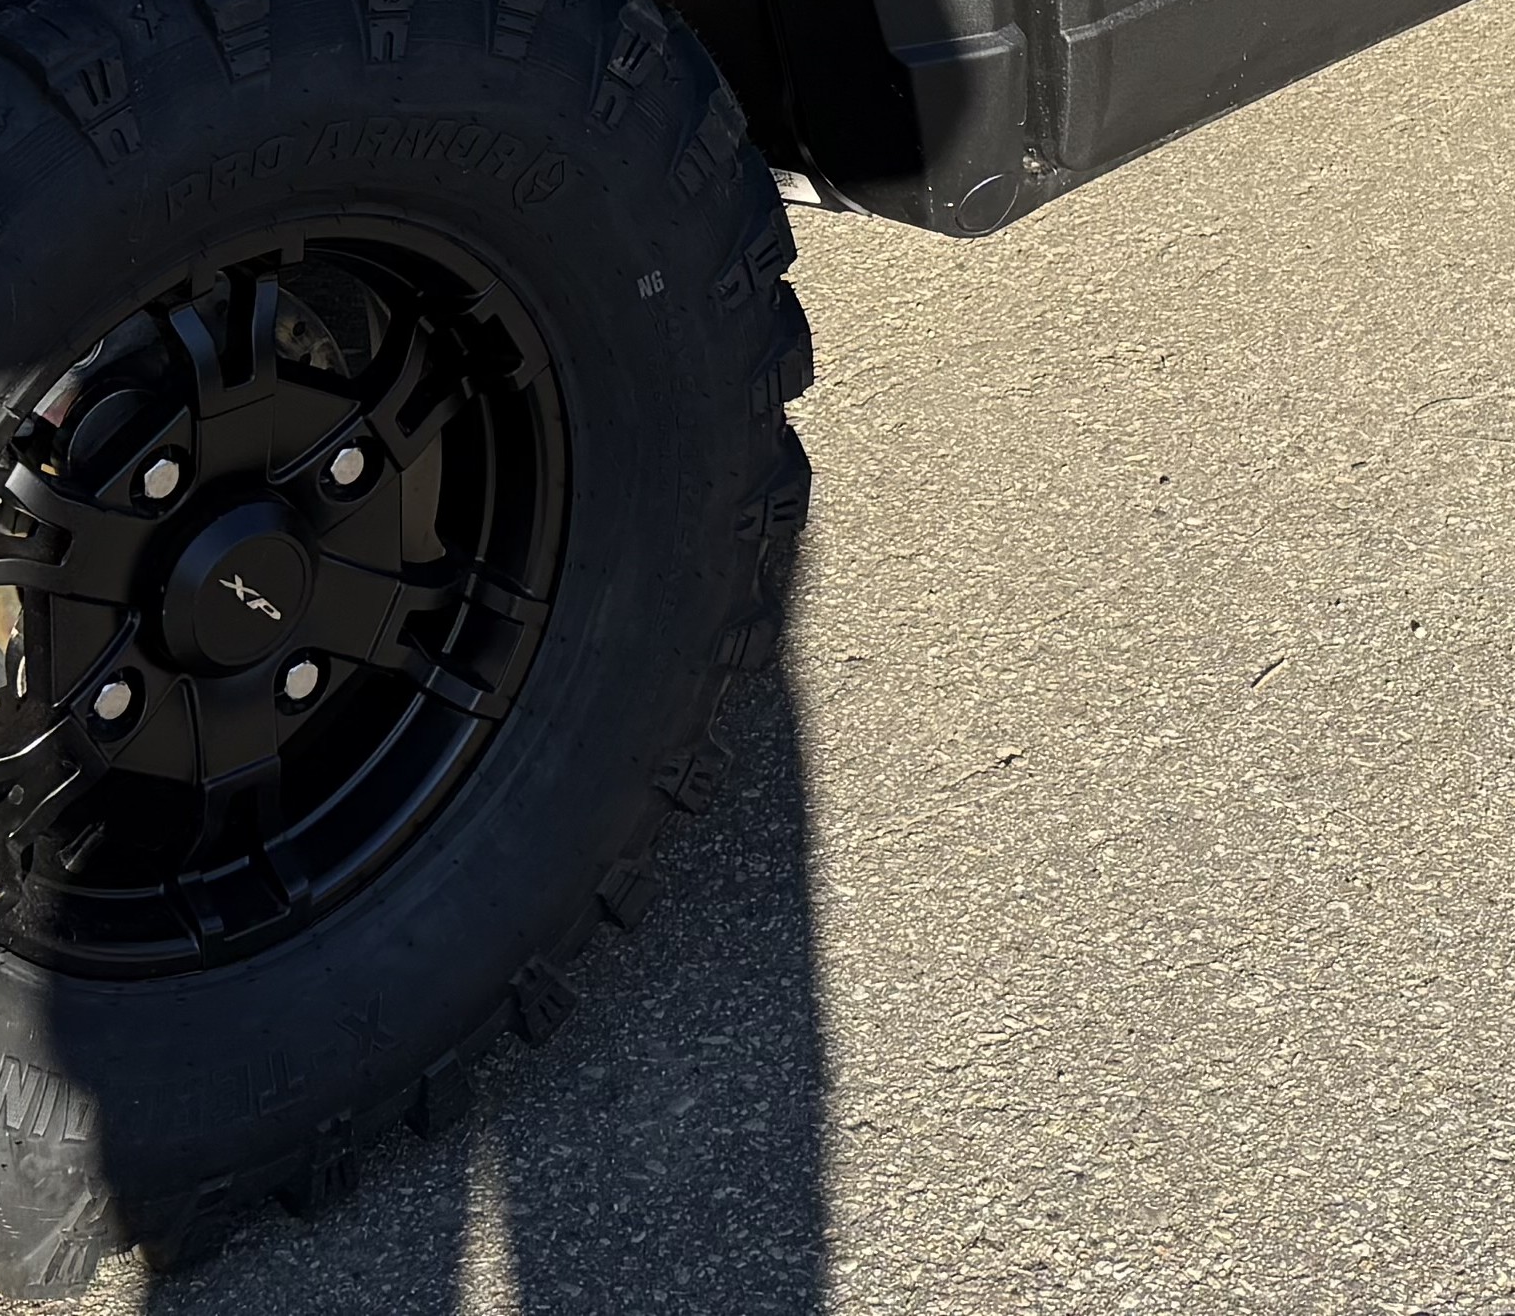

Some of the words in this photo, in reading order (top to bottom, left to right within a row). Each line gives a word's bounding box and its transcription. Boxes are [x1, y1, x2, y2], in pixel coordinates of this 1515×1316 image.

[165, 135, 296, 223] PRO
[304, 116, 526, 182] ARMOR
[218, 572, 284, 624] XP
